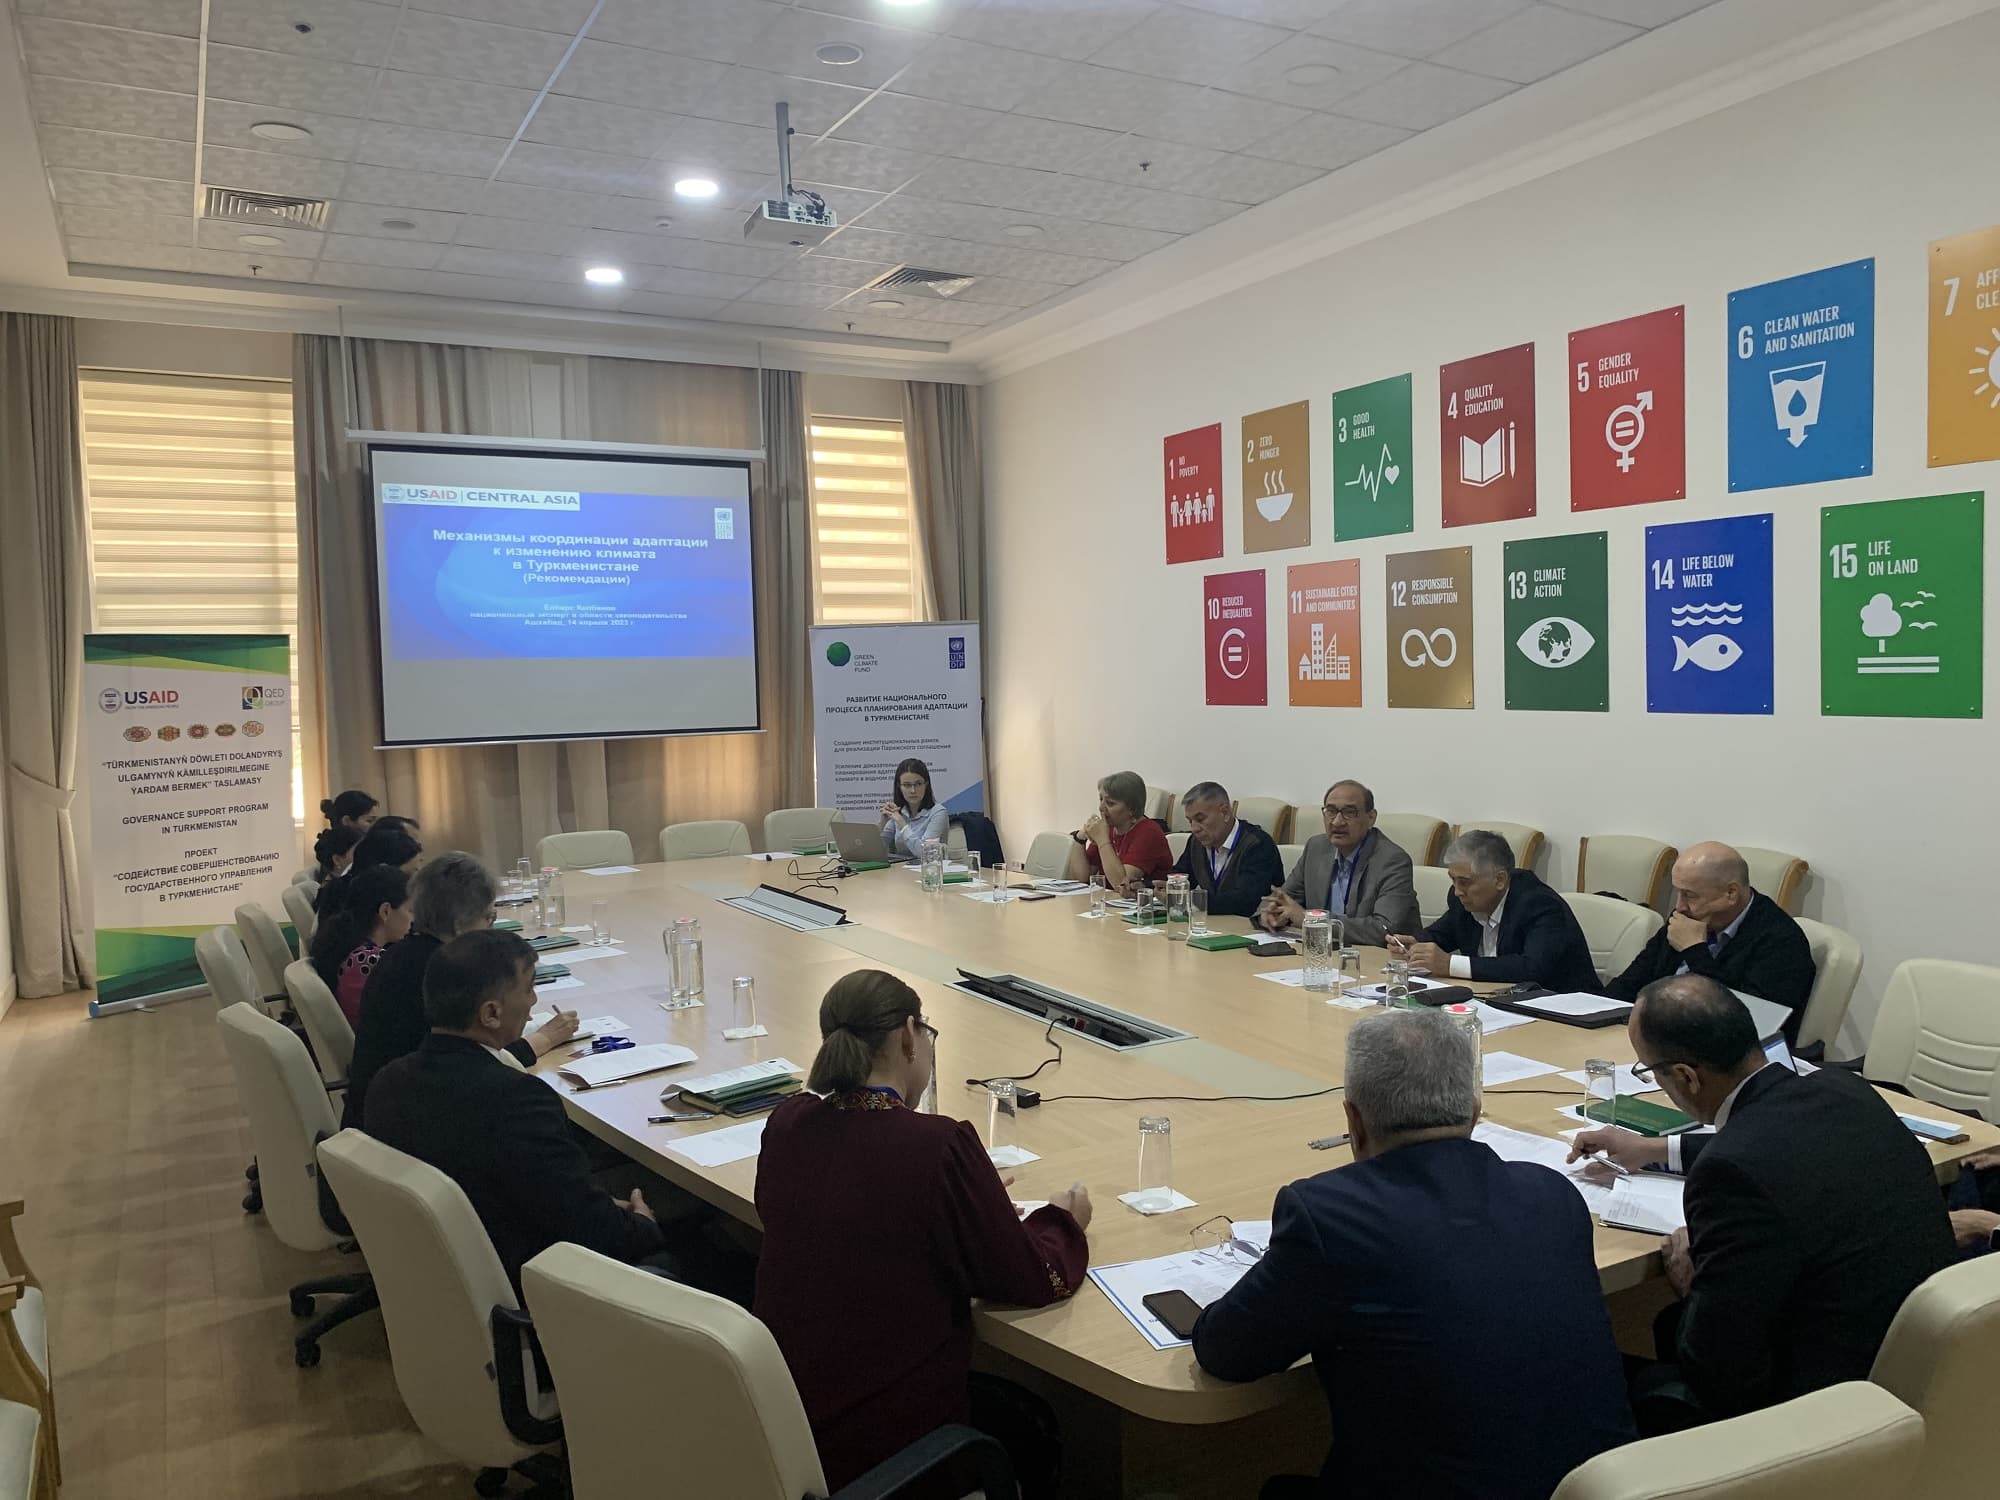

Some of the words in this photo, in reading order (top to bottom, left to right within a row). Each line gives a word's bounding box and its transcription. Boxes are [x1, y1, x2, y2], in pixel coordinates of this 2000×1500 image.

[1976, 268, 2000, 288] AFF
[1944, 277, 1960, 316] 7
[1976, 290, 2000, 310] CLE
[1764, 314, 1800, 336] CLEAN
[1802, 305, 1840, 327] WATER
[1738, 325, 1754, 359] 6
[1765, 335, 1788, 354] AND
[1790, 322, 1855, 350] SANITATION
[1598, 352, 1632, 372] GENDER
[1576, 362, 1590, 392] 5
[1598, 368, 1640, 389] EQUALITY
[1464, 383, 1494, 402] QUALITY
[1446, 392, 1458, 420] 4
[1464, 397, 1504, 417] EDUCATION
[1352, 412, 1370, 426] GOOD
[1338, 417, 1347, 444] 3
[1352, 425, 1376, 441] HEALTH
[1260, 435, 1272, 448] ZERO
[1247, 440, 1254, 463] 2
[1260, 446, 1280, 461] HUNGER
[1168, 458, 1174, 480] 1
[1179, 465, 1198, 478] POVERTY
[407, 488, 458, 500] USAID
[466, 492, 540, 503] CENTRAL
[544, 495, 578, 505] ASIA
[433, 530, 526, 542] Механизмы
[530, 534, 628, 546] координации
[632, 536, 708, 548] адаптации
[493, 548, 501, 556] к
[506, 548, 592, 558] изменению
[596, 550, 656, 559] климата
[1868, 540, 1891, 557] LIFE
[512, 562, 522, 570] в
[527, 560, 640, 572] Туркменистане
[1682, 556, 1701, 571] LIFE
[1702, 554, 1734, 570] BELOW
[1829, 543, 1858, 578] 15
[1868, 560, 1884, 576] ON
[1886, 557, 1918, 576] LAND
[523, 573, 630, 586] (Рекомендации)
[1533, 566, 1566, 582] CLIMATE
[1651, 559, 1675, 590] 14
[1682, 572, 1714, 589] WATER
[1411, 576, 1454, 591] RESPONSIBLE
[1508, 570, 1528, 600] 13
[1534, 582, 1563, 598] ACTION
[1222, 596, 1244, 607] REDUCED
[1305, 587, 1340, 600] SUSTAINABLE
[1340, 586, 1358, 597] CITIES
[1391, 580, 1407, 607] 12
[1412, 592, 1458, 606] CONSUMPTION
[1208, 598, 1220, 620] 10
[1291, 590, 1302, 614] 11
[1306, 602, 1318, 612] AND
[1318, 600, 1356, 612] COMMUNITIES
[1222, 607, 1252, 619] INEQUALITIES
[124, 690, 180, 704] USAID
[264, 688, 284, 698] QED
[846, 696, 882, 704] РАЗВИТИЕ
[883, 694, 947, 702] НАЦИОНАЛЬНОГО
[826, 706, 862, 714] ПРОЦЕССА
[864, 704, 922, 712] ПЛАНИРОВАНИЯ
[924, 703, 968, 711] АДАПТАЦИИ
[871, 714, 930, 722] ТУРКМЕНИСТАНЕ
[214, 776, 262, 788] TASLAMASY
[122, 811, 185, 825] GOVERNANCE
[186, 808, 226, 818] SUPPORT
[228, 803, 269, 814] PROGRAM
[162, 826, 170, 834] IN
[174, 820, 238, 833] TURKMENISTAN
[184, 848, 218, 858] ПРОЕКТ
[180, 852, 280, 872] СОВЕРШЕНСТВОВАНИЮ
[124, 874, 218, 894] ГОСУДАРСТВЕННОГО
[219, 866, 273, 880] УПРАВЛЕНИЯ
[160, 894, 166, 902] В
